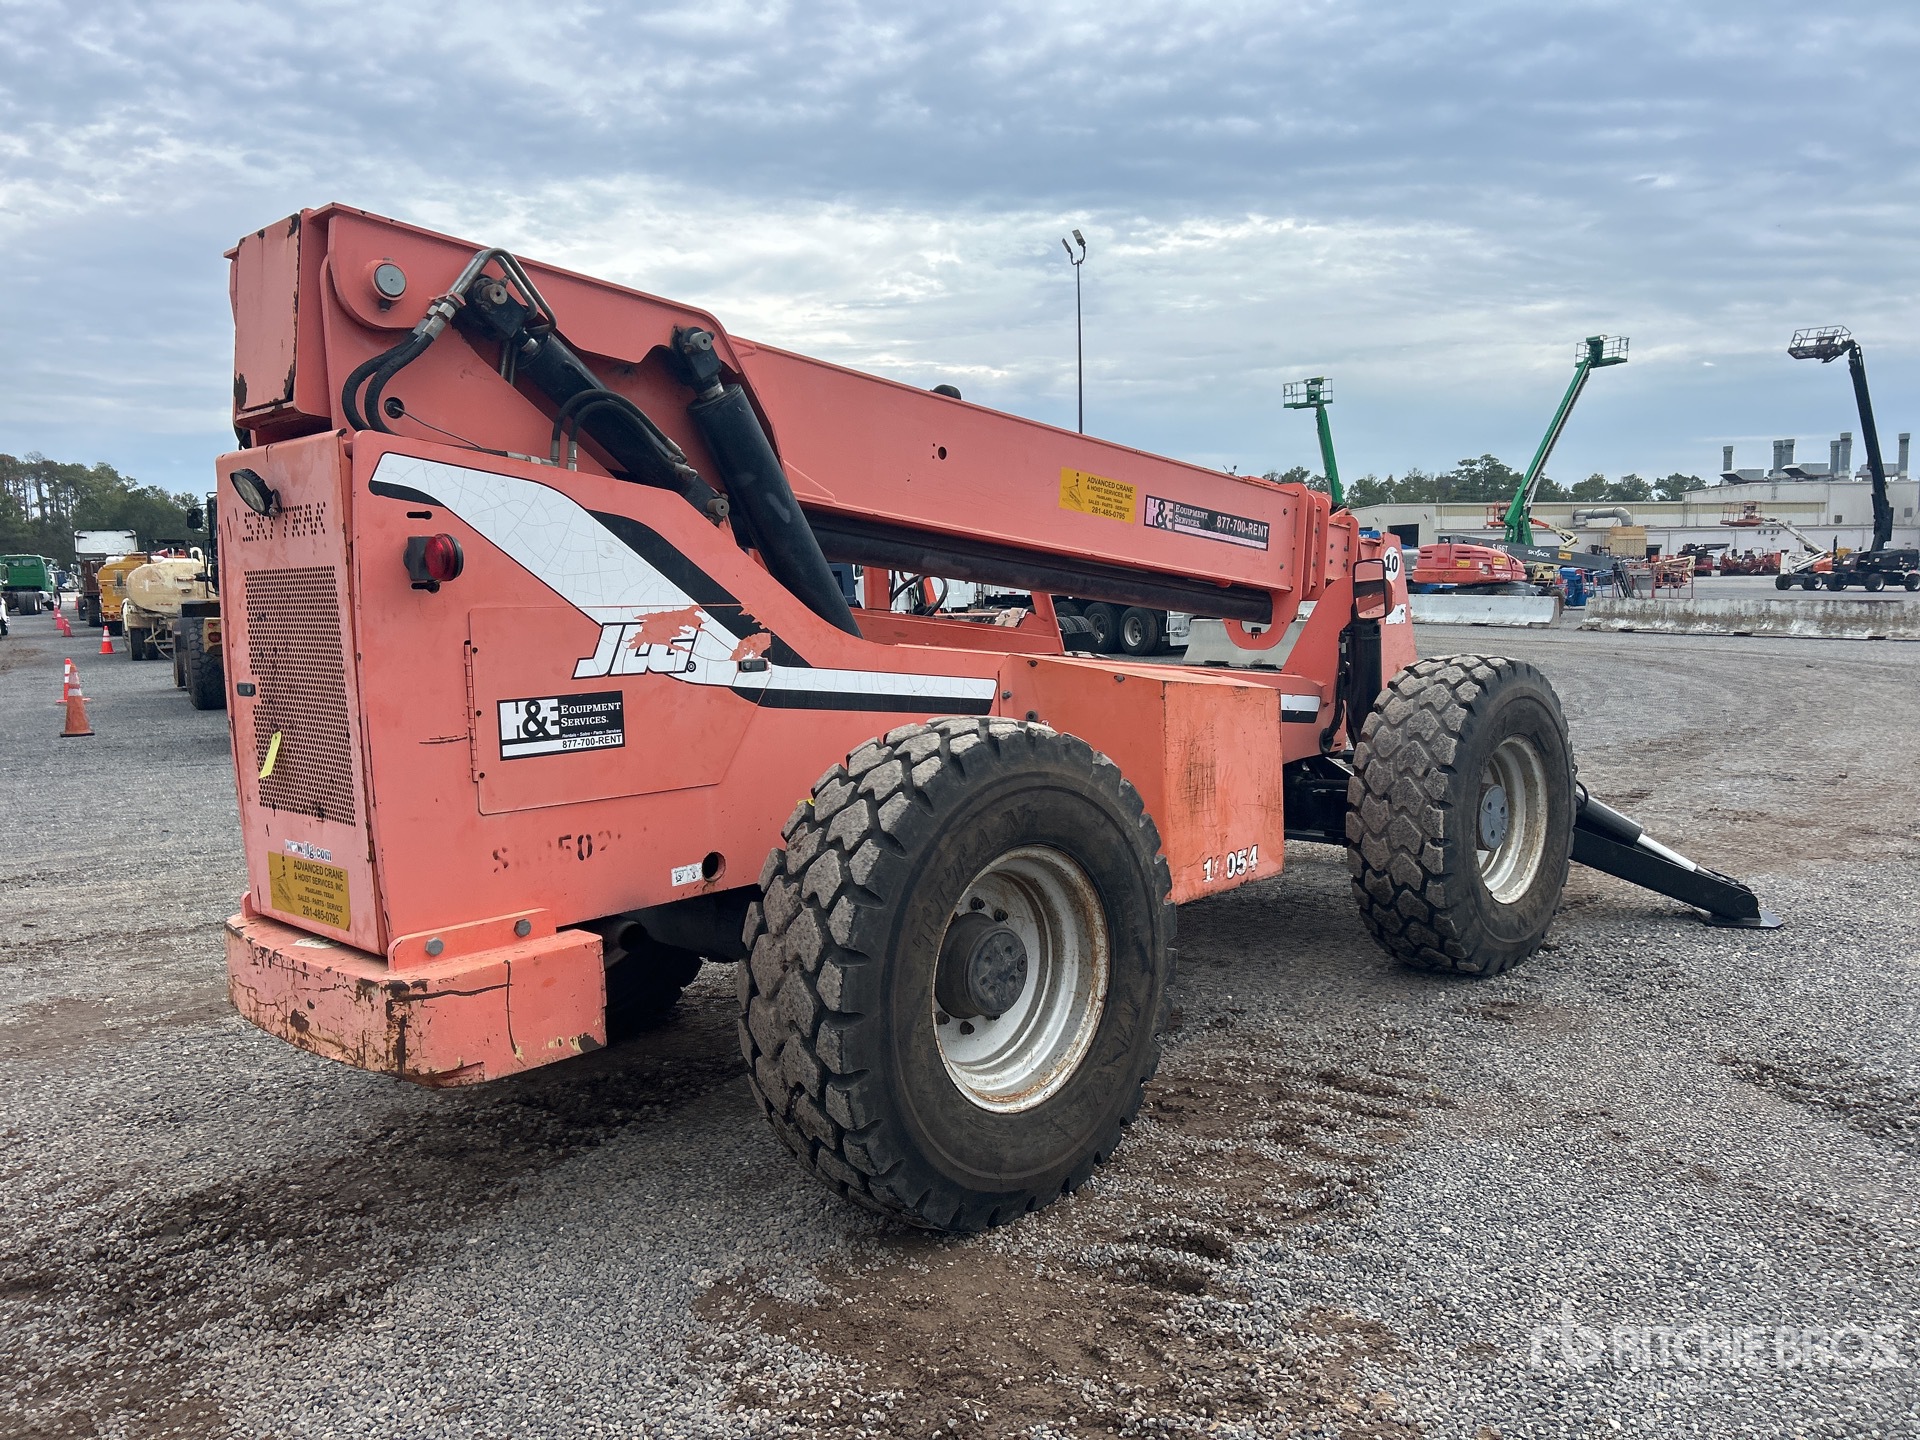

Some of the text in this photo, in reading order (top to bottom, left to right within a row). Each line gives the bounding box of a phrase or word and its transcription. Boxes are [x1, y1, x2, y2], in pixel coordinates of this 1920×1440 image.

[1087, 476, 1133, 493] ADVANCED CRANE
[1091, 485, 1103, 494] HOIST
[1091, 506, 1126, 520] 281-485-0795
[1146, 497, 1209, 530] H&E EQUIPMENT
[1216, 515, 1269, 538] 877-700-RENT
[1384, 554, 1398, 573] 10
[500, 699, 621, 740] H&E EQUIPMENT
[562, 735, 621, 748] 877-700-RENT
[294, 860, 343, 882] ADVANCED CRANE
[298, 873, 311, 883] HOIST
[302, 905, 340, 925] 281-485-0795
